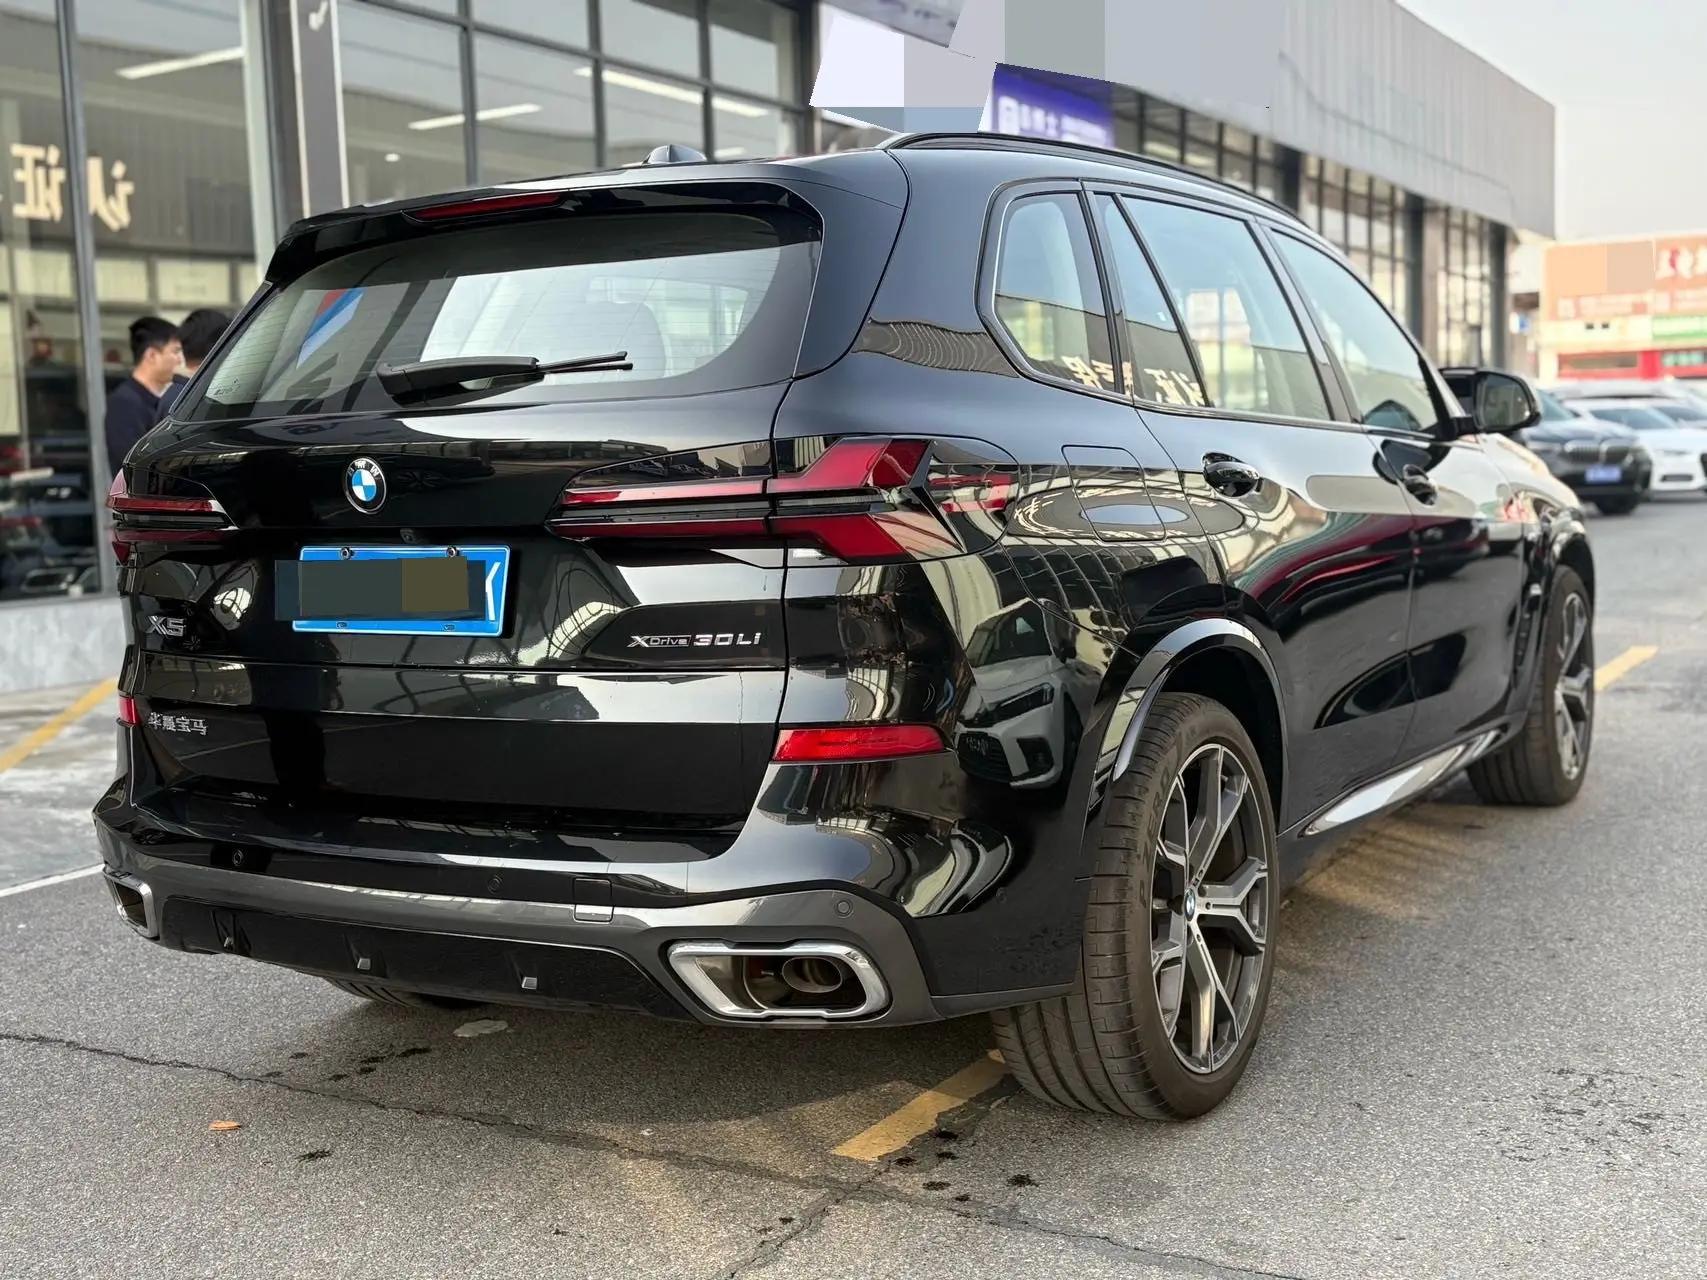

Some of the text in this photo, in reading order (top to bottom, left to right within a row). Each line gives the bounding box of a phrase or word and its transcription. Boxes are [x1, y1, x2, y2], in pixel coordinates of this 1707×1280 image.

[145, 616, 185, 637] X5
[148, 712, 206, 736] 华晨宝马
